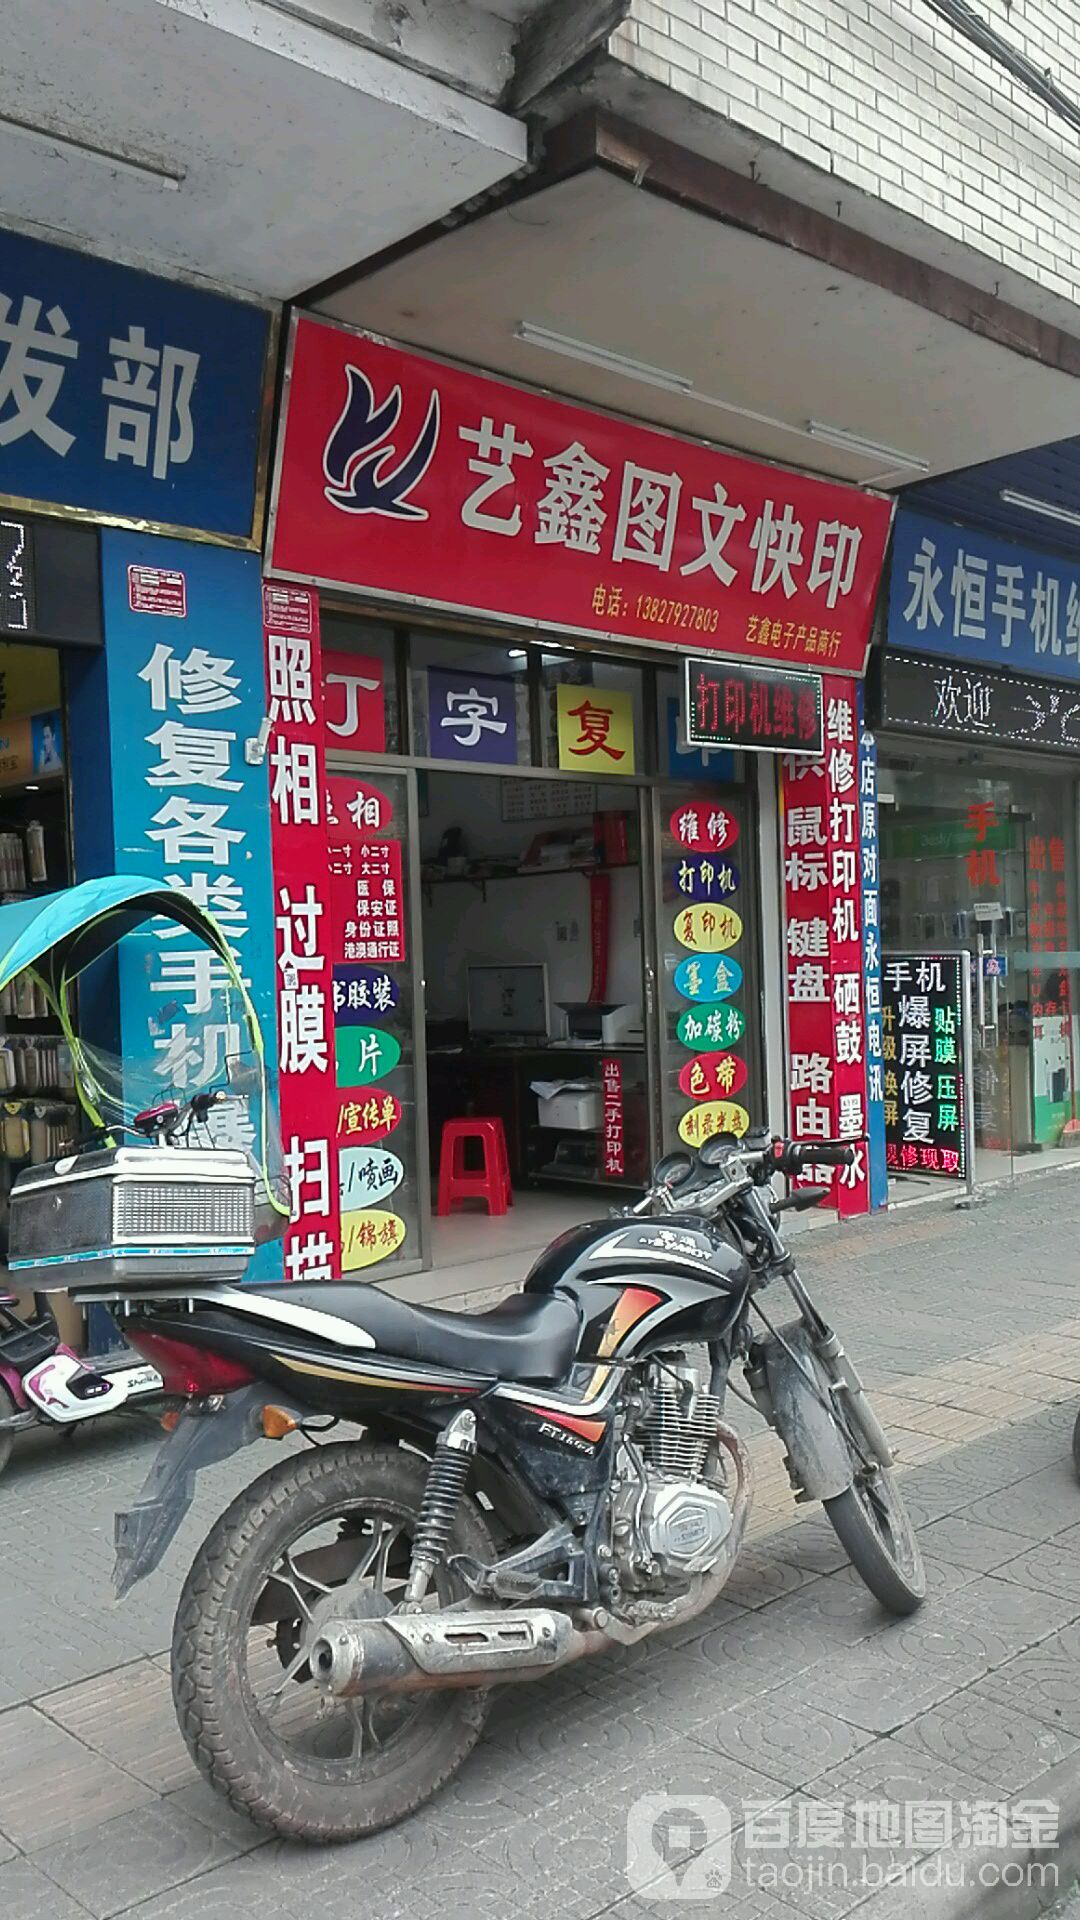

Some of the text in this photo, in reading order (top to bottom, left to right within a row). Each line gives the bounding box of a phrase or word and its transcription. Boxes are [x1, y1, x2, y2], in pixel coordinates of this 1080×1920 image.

[458, 416, 863, 609] 艺鑫图文快印
[745, 614, 843, 658] 艺鑫电子产品商行
[268, 635, 319, 825] 照相
[440, 688, 508, 747] 字
[566, 699, 626, 761] 复
[696, 671, 817, 740] 打印机维修
[932, 675, 994, 728] 欢迎
[326, 790, 381, 829] 相
[678, 810, 730, 847] 维修
[827, 699, 859, 943] 维修打印机
[328, 844, 352, 858] 一寸
[328, 863, 353, 875] 二寸
[785, 806, 829, 892] 鼠标
[964, 802, 1000, 887] 手机
[678, 859, 736, 894] 打印机
[344, 920, 400, 938] 身份证照
[682, 910, 737, 944] 复印机
[275, 885, 328, 1073] 过膜
[684, 960, 733, 995] 墨盒
[787, 917, 831, 1002] 键盘
[883, 960, 946, 992] 手机
[684, 1009, 743, 1042] 加碳粉
[833, 972, 863, 1065] 硒鼓
[689, 1056, 736, 1094] 色带
[898, 994, 935, 1145] 爆屏修复
[934, 1005, 960, 1132] 贴膜压屏
[604, 1063, 624, 1173] 出售二手打印机
